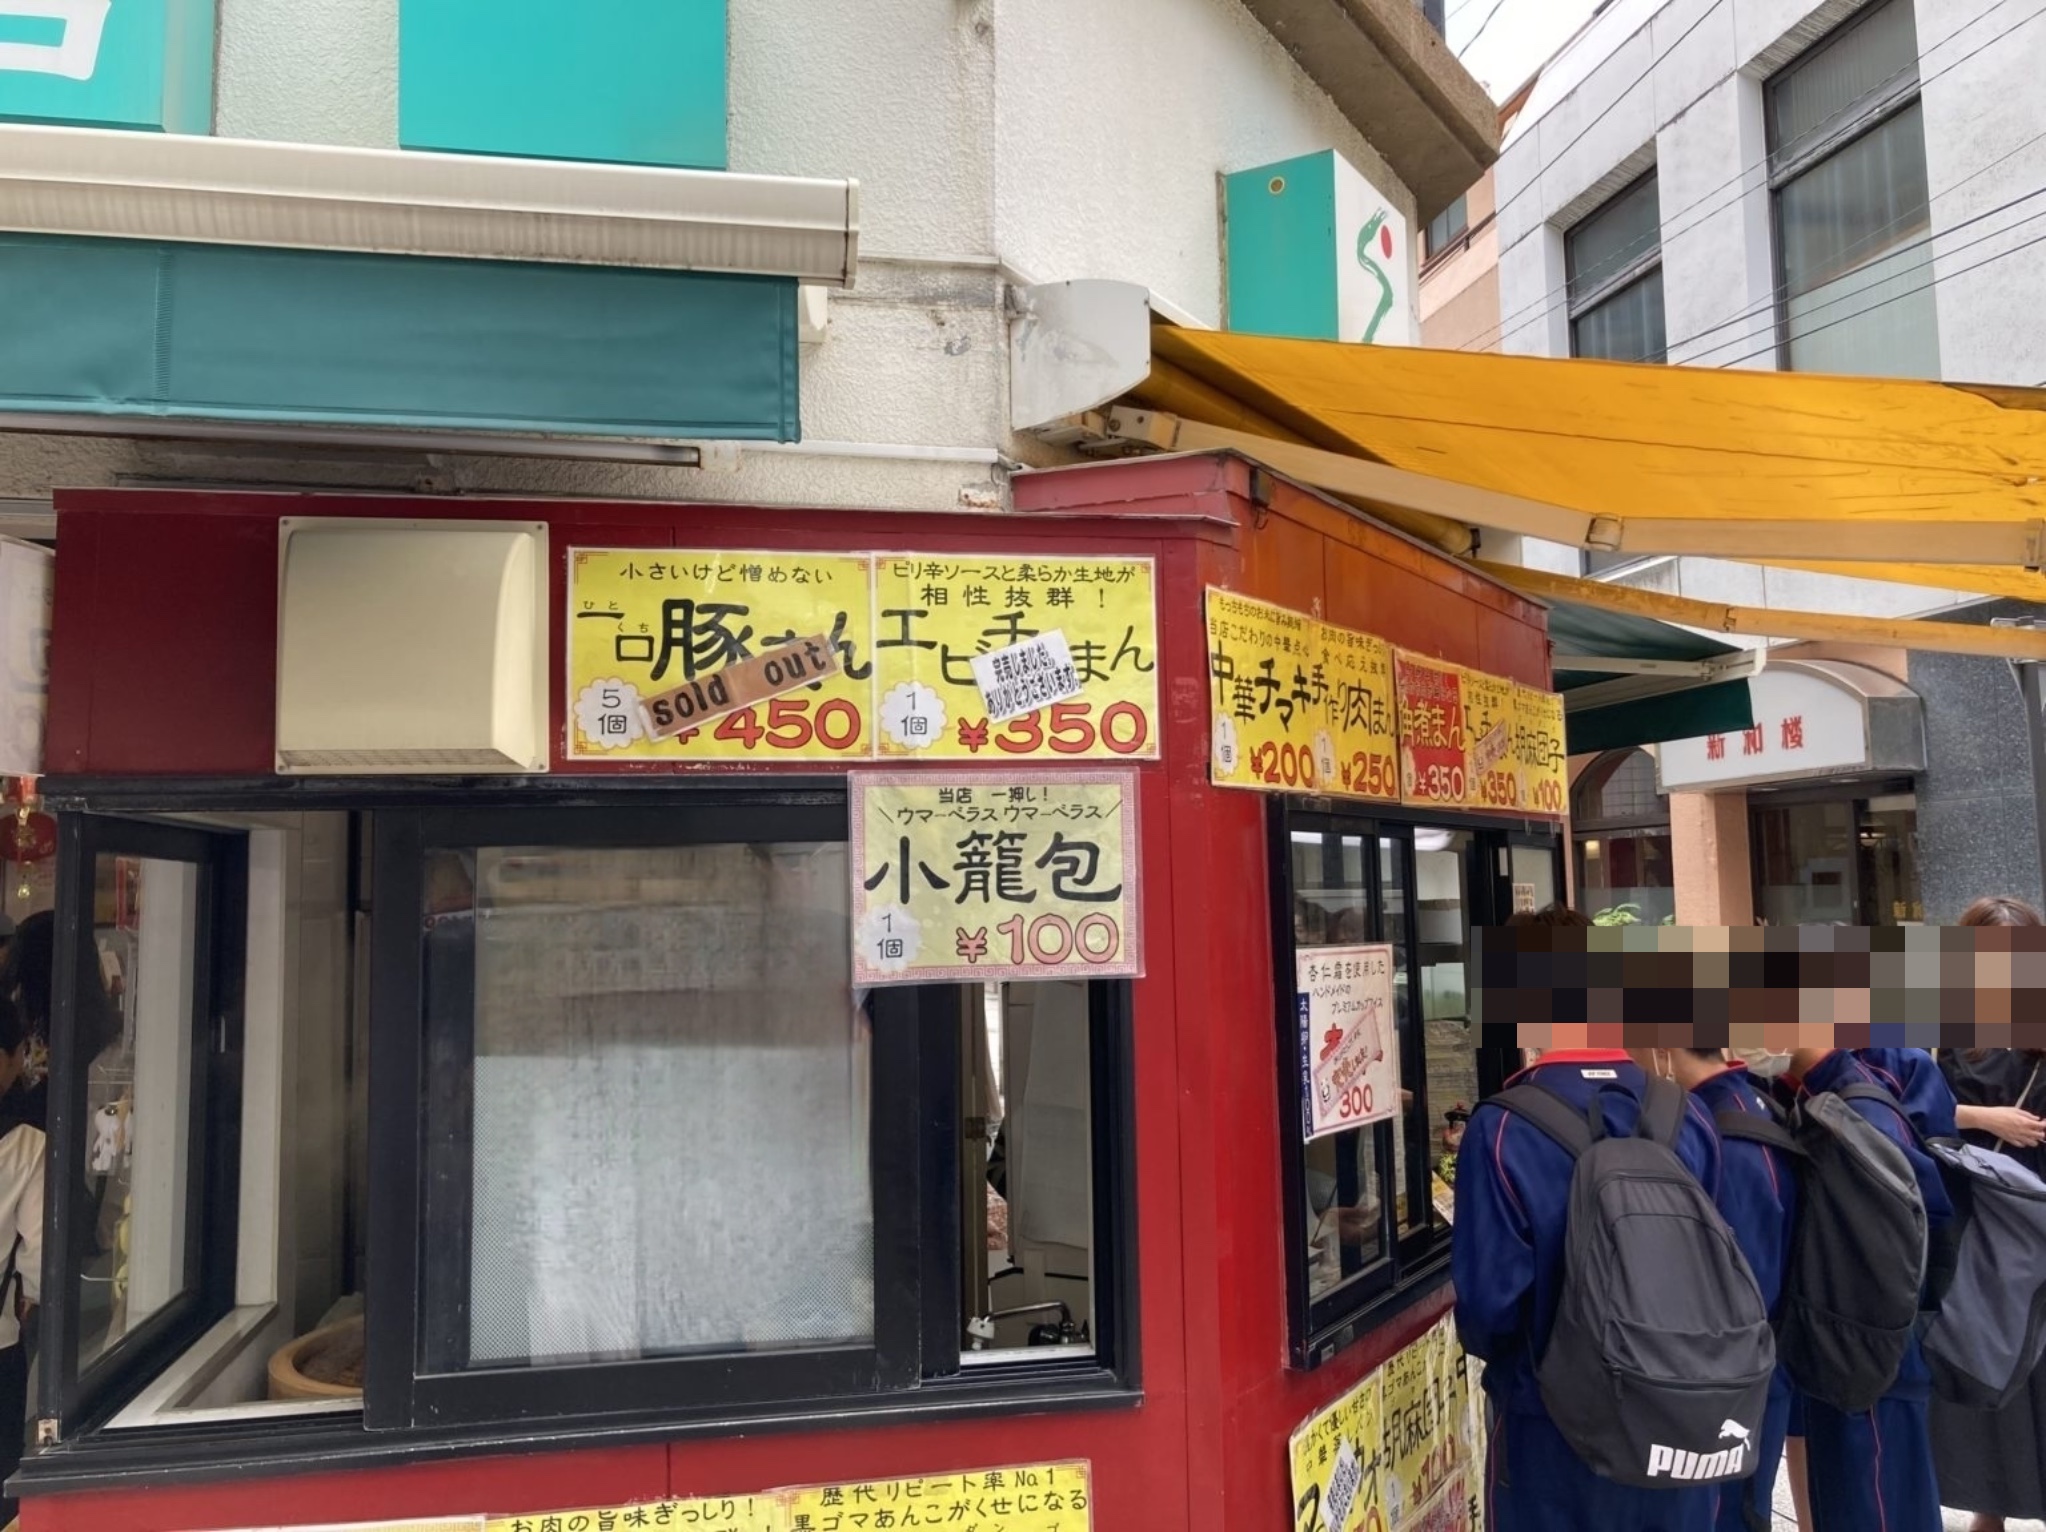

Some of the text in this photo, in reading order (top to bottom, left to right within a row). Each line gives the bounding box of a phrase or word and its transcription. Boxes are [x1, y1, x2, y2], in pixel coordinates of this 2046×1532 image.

[620, 562, 833, 584] 小さいけど憎めない
[893, 561, 1136, 583] ピリ辛ソースと柔らか生地が
[652, 641, 827, 727] sold out
[1210, 639, 1312, 734] 中華チマキ
[1706, 715, 1805, 761] 新和楼
[1249, 740, 1316, 788] ¥200
[1340, 750, 1396, 797] ¥250
[1418, 763, 1465, 802] ¥350
[938, 786, 973, 804] 当店
[1480, 769, 1516, 807] ¥350
[863, 829, 1123, 905] 小籠包
[955, 911, 1120, 965] ¥100
[1339, 1083, 1373, 1118] 300
[1646, 1443, 1745, 1480] PUMA
